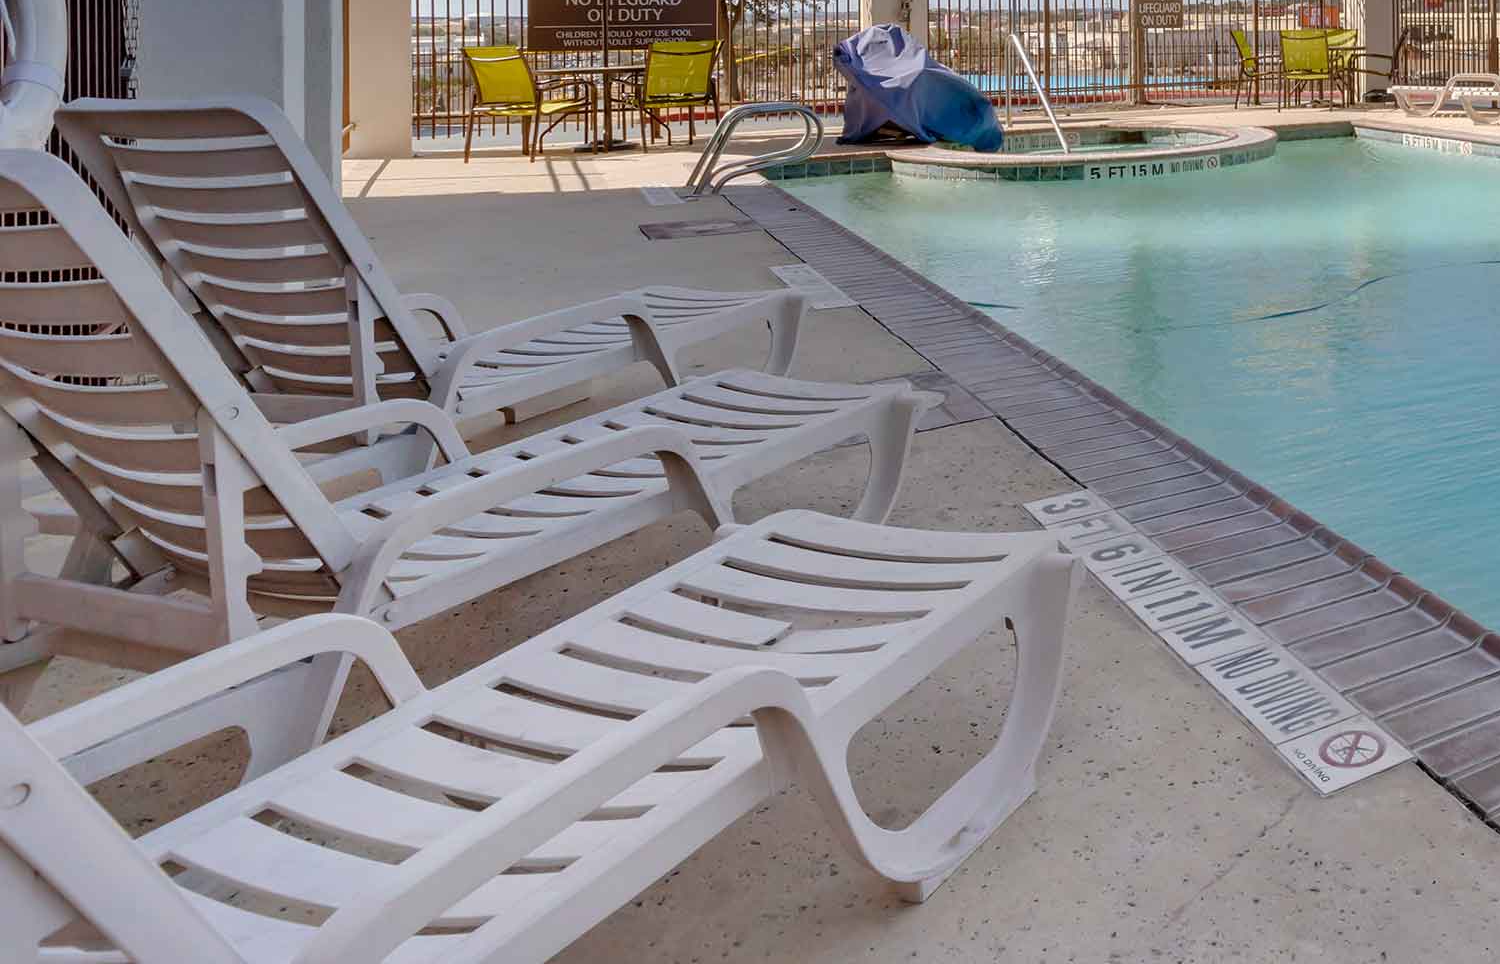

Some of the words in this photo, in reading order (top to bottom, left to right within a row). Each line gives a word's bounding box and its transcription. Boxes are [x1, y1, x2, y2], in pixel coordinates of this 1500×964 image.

[587, 9, 612, 22] ON
[618, 9, 663, 22] DUTY
[1139, 3, 1181, 13] LIFEGUARD
[1141, 15, 1155, 26] ON
[1156, 15, 1178, 25] DUTY
[556, 30, 598, 39] CHILDREN
[655, 29, 670, 37] USE
[672, 28, 693, 37] POOL
[563, 39, 604, 47] WITHOUT
[1090, 167, 1101, 179] 5
[1109, 166, 1126, 178] FT
[1152, 163, 1164, 175] M
[1042, 498, 1092, 515] 3
[1061, 513, 1120, 540] FT
[1090, 543, 1144, 562] 6
[1112, 561, 1181, 594] IN
[1175, 616, 1248, 650] M
[1210, 646, 1281, 679] NO
[1234, 669, 1341, 734] DIVING
